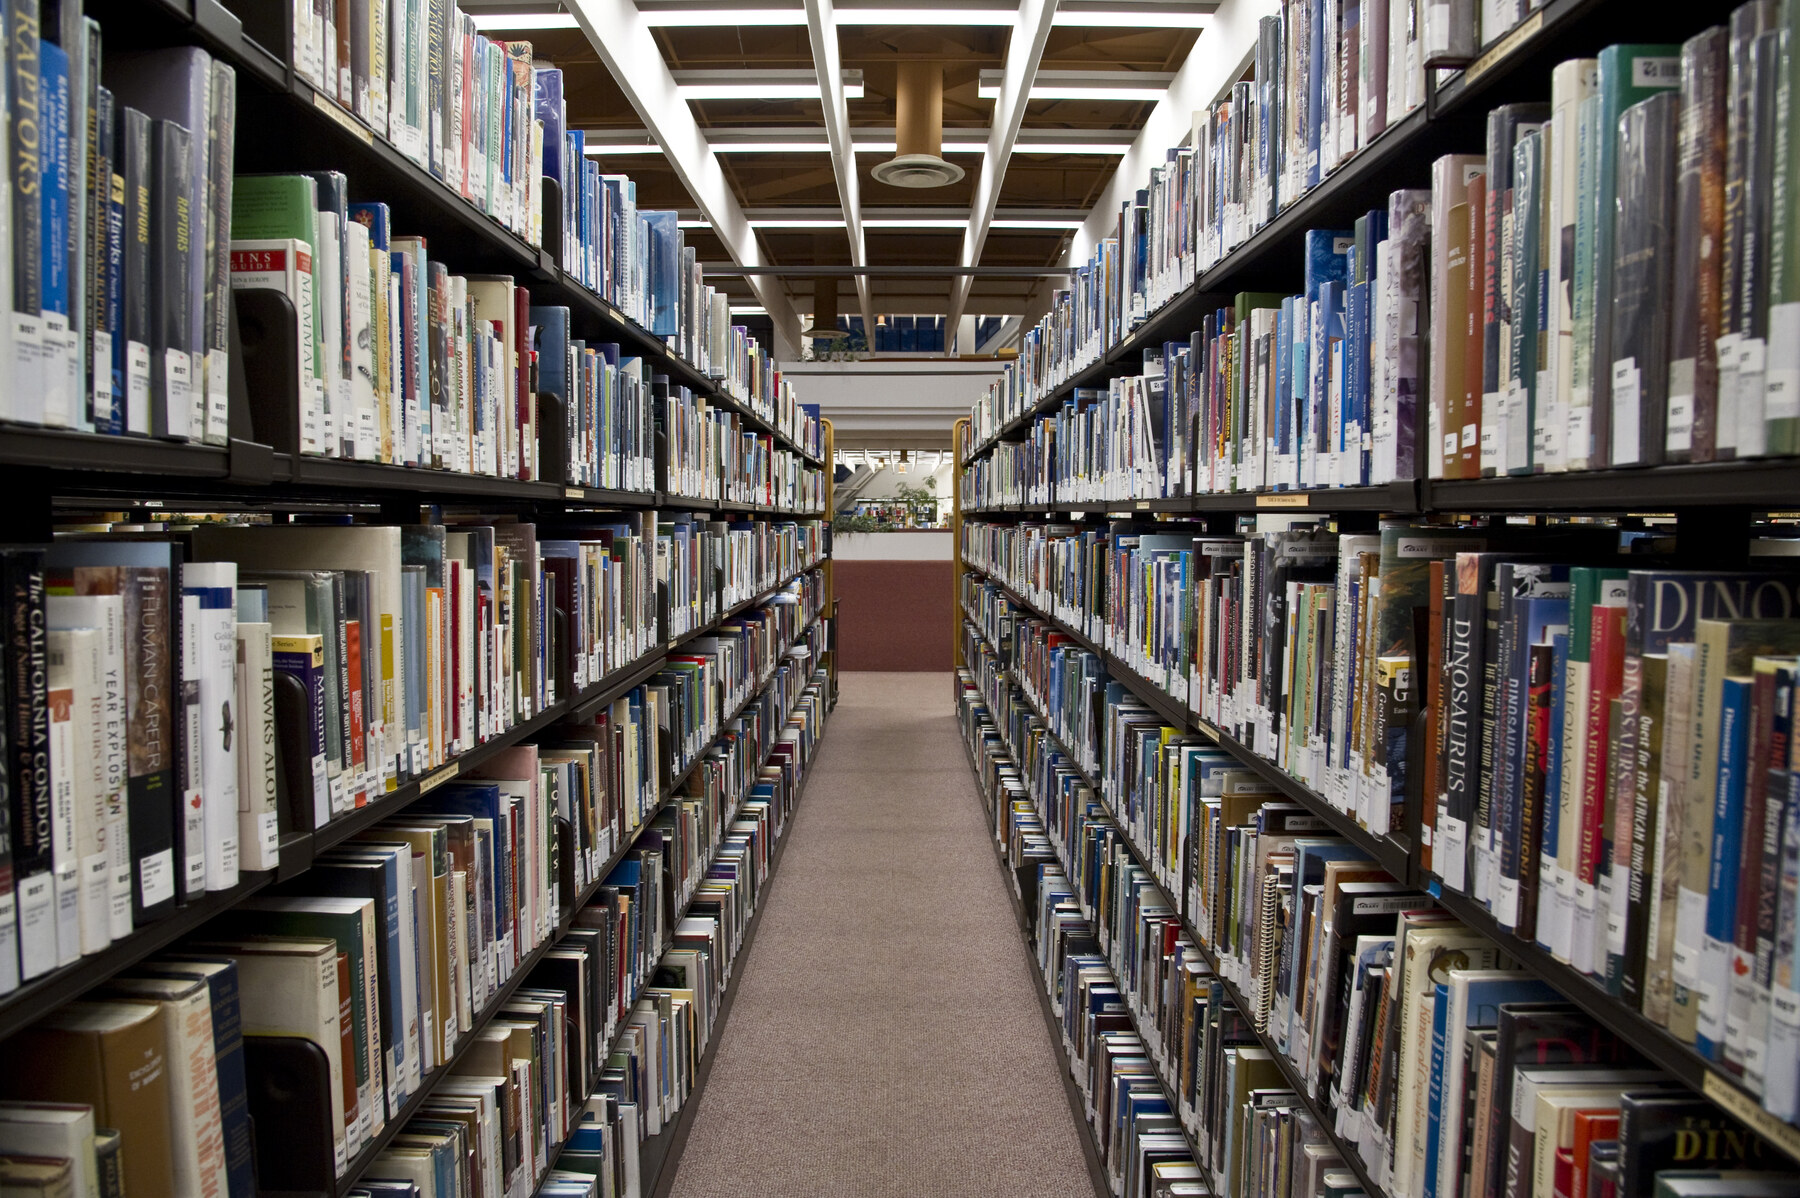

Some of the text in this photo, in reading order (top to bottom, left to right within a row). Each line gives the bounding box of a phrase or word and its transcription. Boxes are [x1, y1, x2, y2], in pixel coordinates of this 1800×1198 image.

[409, 22, 417, 87] MAMMALS
[430, 14, 439, 80] EVOLUTION
[16, 10, 39, 195] RAPTORS
[57, 75, 68, 190] RAPTOR WATCH
[87, 142, 96, 190] EAGLES
[110, 211, 123, 265] Hawks
[137, 186, 149, 244] RAPTORS
[176, 196, 189, 253] RAPTORS
[1513, 188, 1527, 280] Mesozoic
[110, 277, 118, 299] North
[1485, 190, 1497, 325] DINOSAURS
[110, 302, 118, 332] America
[1390, 271, 1400, 384] SMITHSONIAN
[1537, 271, 1545, 330] DINOSAURS
[456, 350, 464, 410] MAMMALS
[1279, 319, 1287, 385] ELIXIR
[1317, 322, 1325, 402] WATER
[1348, 343, 1354, 359] OF
[1341, 572, 1349, 636] GRANITE
[1352, 566, 1365, 702] ORIGINS OF ARABIA
[1594, 615, 1603, 642] MARK
[339, 619, 347, 665] FURBEARING
[1339, 640, 1347, 669] AND
[141, 597, 161, 767] HUMAN CAREER
[262, 667, 275, 746] HAWKS
[1449, 619, 1471, 793] DINOSAURUS
[1550, 655, 1560, 707] WARD
[1692, 642, 1710, 780] Dinosaurs of Utah
[29, 572, 51, 855] The CALIFORNIA CONDOR
[90, 696, 104, 760] RETURN
[106, 669, 120, 815] YEAR EXPLOSION
[1376, 692, 1387, 744] Geology
[1481, 662, 1498, 768] THE GREAT DINOSAUR
[1559, 665, 1577, 815] PALEOIMAGERY
[1617, 656, 1641, 781] DINOSAURS
[93, 765, 104, 781] OF
[1503, 677, 1520, 832] DINOSAUR ODYSSEY
[1584, 689, 1602, 807] UNEARTHING
[1609, 740, 1618, 801] HUNTERS
[1717, 707, 1735, 818] Dinosaur Country
[95, 791, 106, 820] THE
[1520, 693, 1539, 877] DINOSAUR IMPRESSIONS
[1543, 738, 1556, 826] OUT THIN
[1628, 715, 1654, 904] Quest for the AFRICAN DINOSAURS
[550, 772, 560, 869] KOALAS
[1758, 861, 1777, 931] TEXAS
[322, 970, 335, 981] Pacific
[322, 978, 335, 989] States
[357, 958, 365, 992] Mammals
[369, 973, 379, 1031] Mammals
[1404, 968, 1412, 986] THE
[360, 1017, 368, 1043] Pacific
[372, 1033, 381, 1045] of
[1378, 979, 1390, 1042] DRIVING
[1401, 989, 1410, 1038] ULTIMATE
[372, 1047, 381, 1089] Alaska
[1413, 1004, 1431, 1136] Kings of Creation
[508, 1092, 516, 1128] Societies
[1535, 1125, 1549, 1188] Dinosaur
